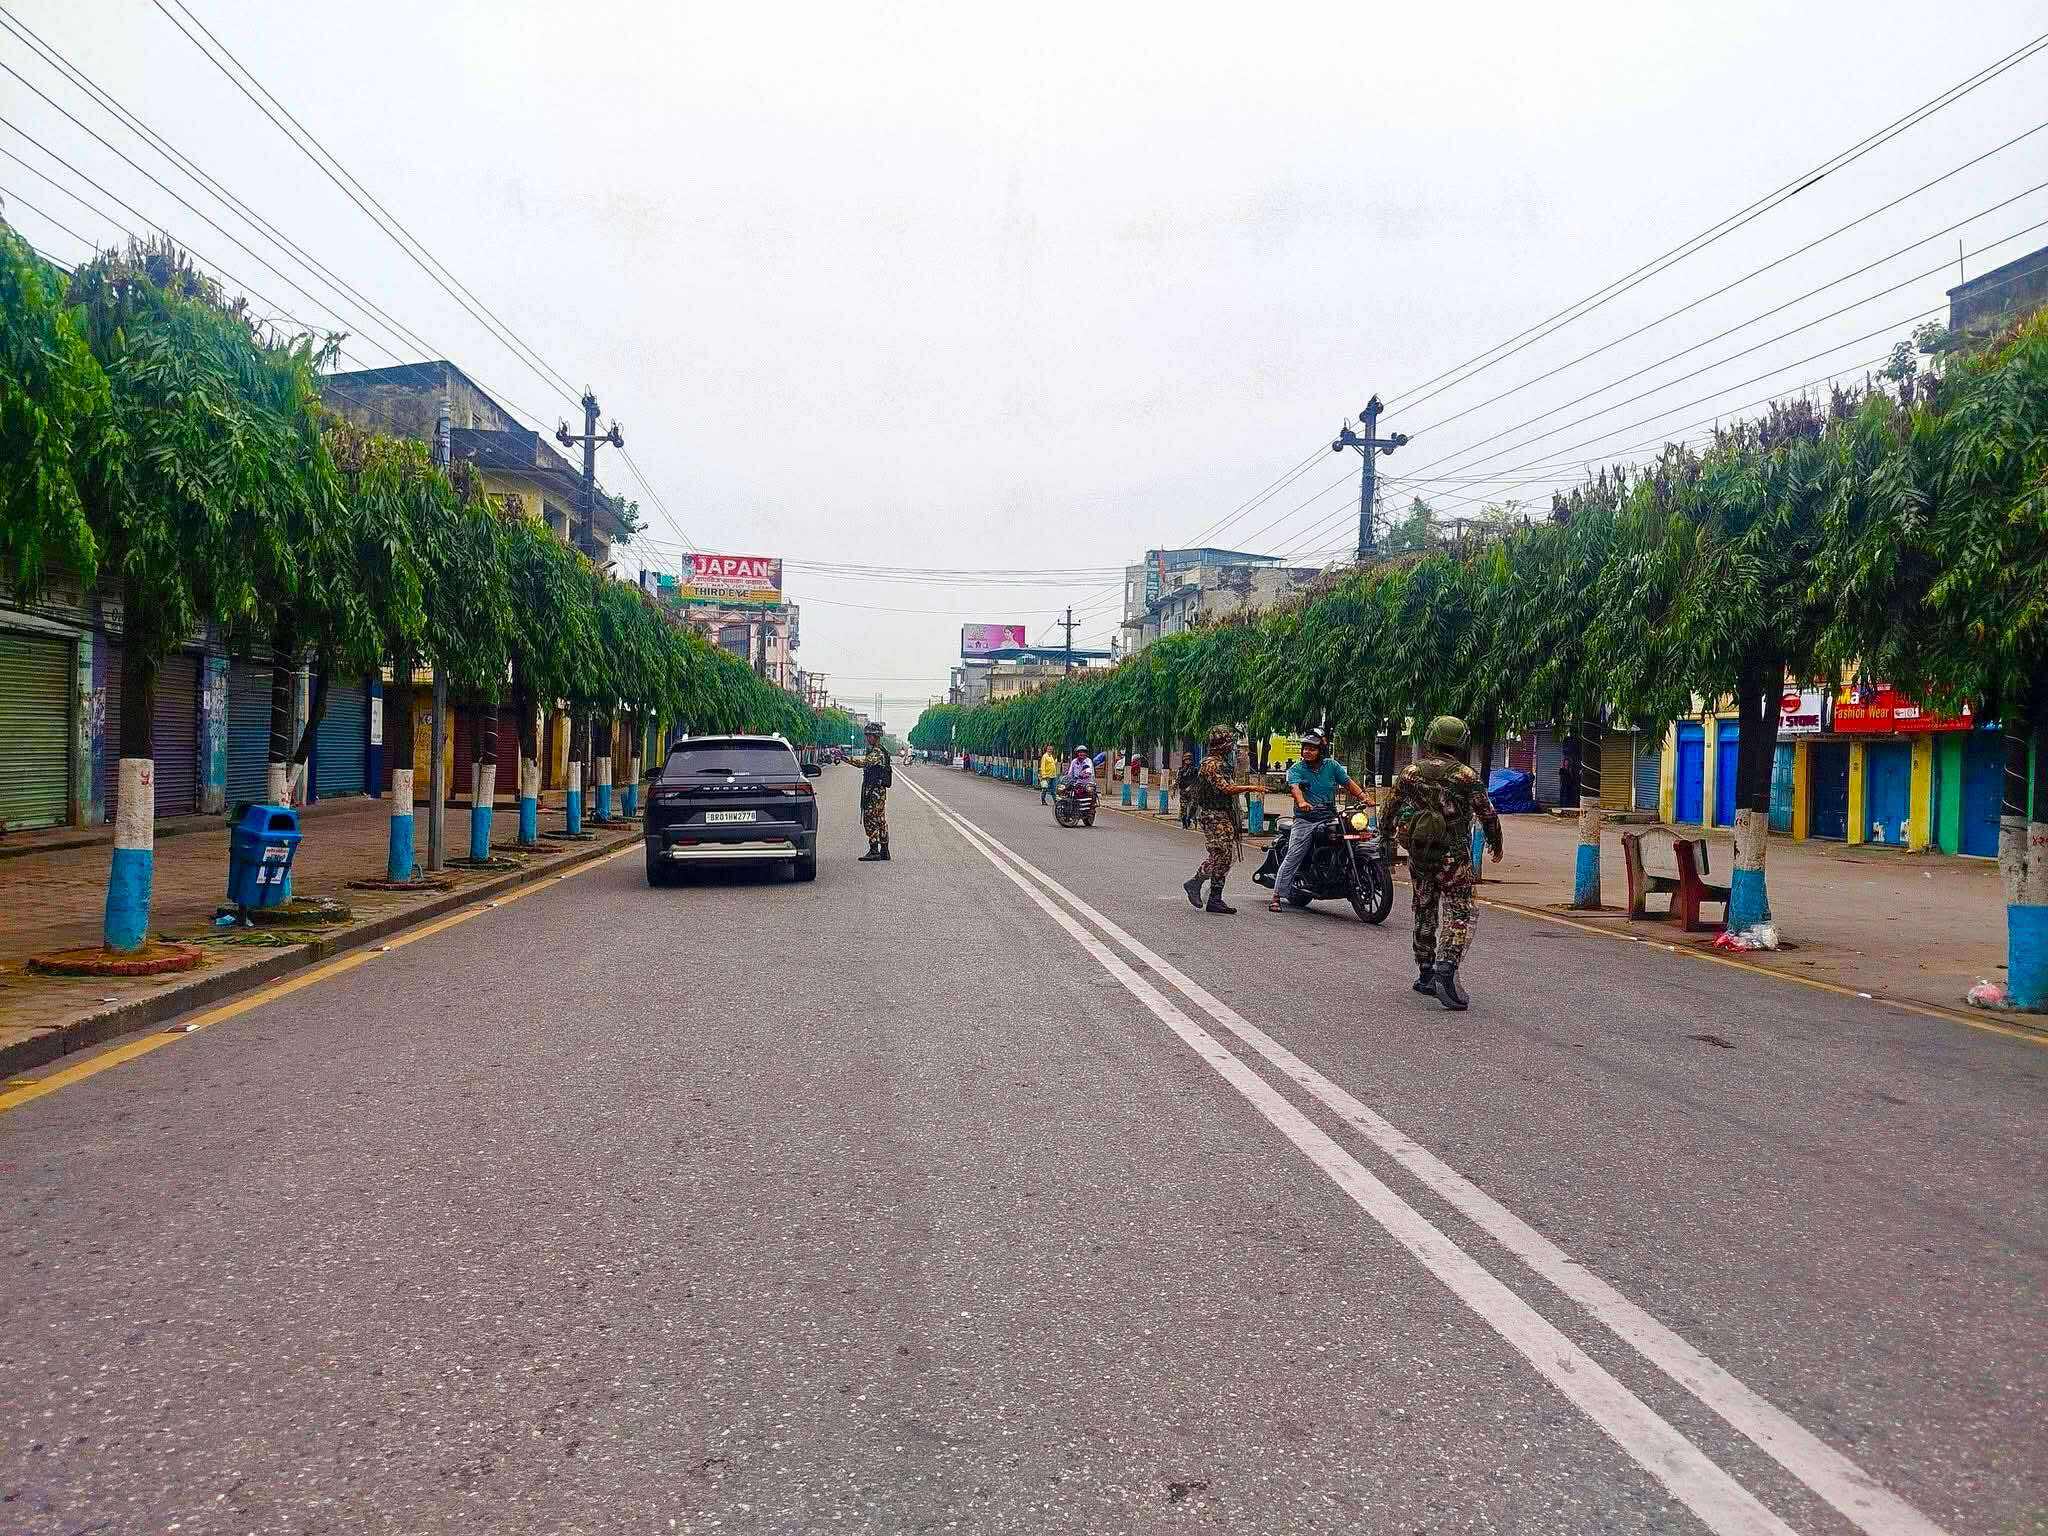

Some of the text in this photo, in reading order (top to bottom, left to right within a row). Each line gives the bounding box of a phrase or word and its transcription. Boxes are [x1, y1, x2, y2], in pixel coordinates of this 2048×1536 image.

[696, 556, 768, 577] JAPAN
[694, 587, 749, 598] THIRD EYE
[1834, 706, 1866, 719] Fashion
[1869, 705, 1890, 719] Wear
